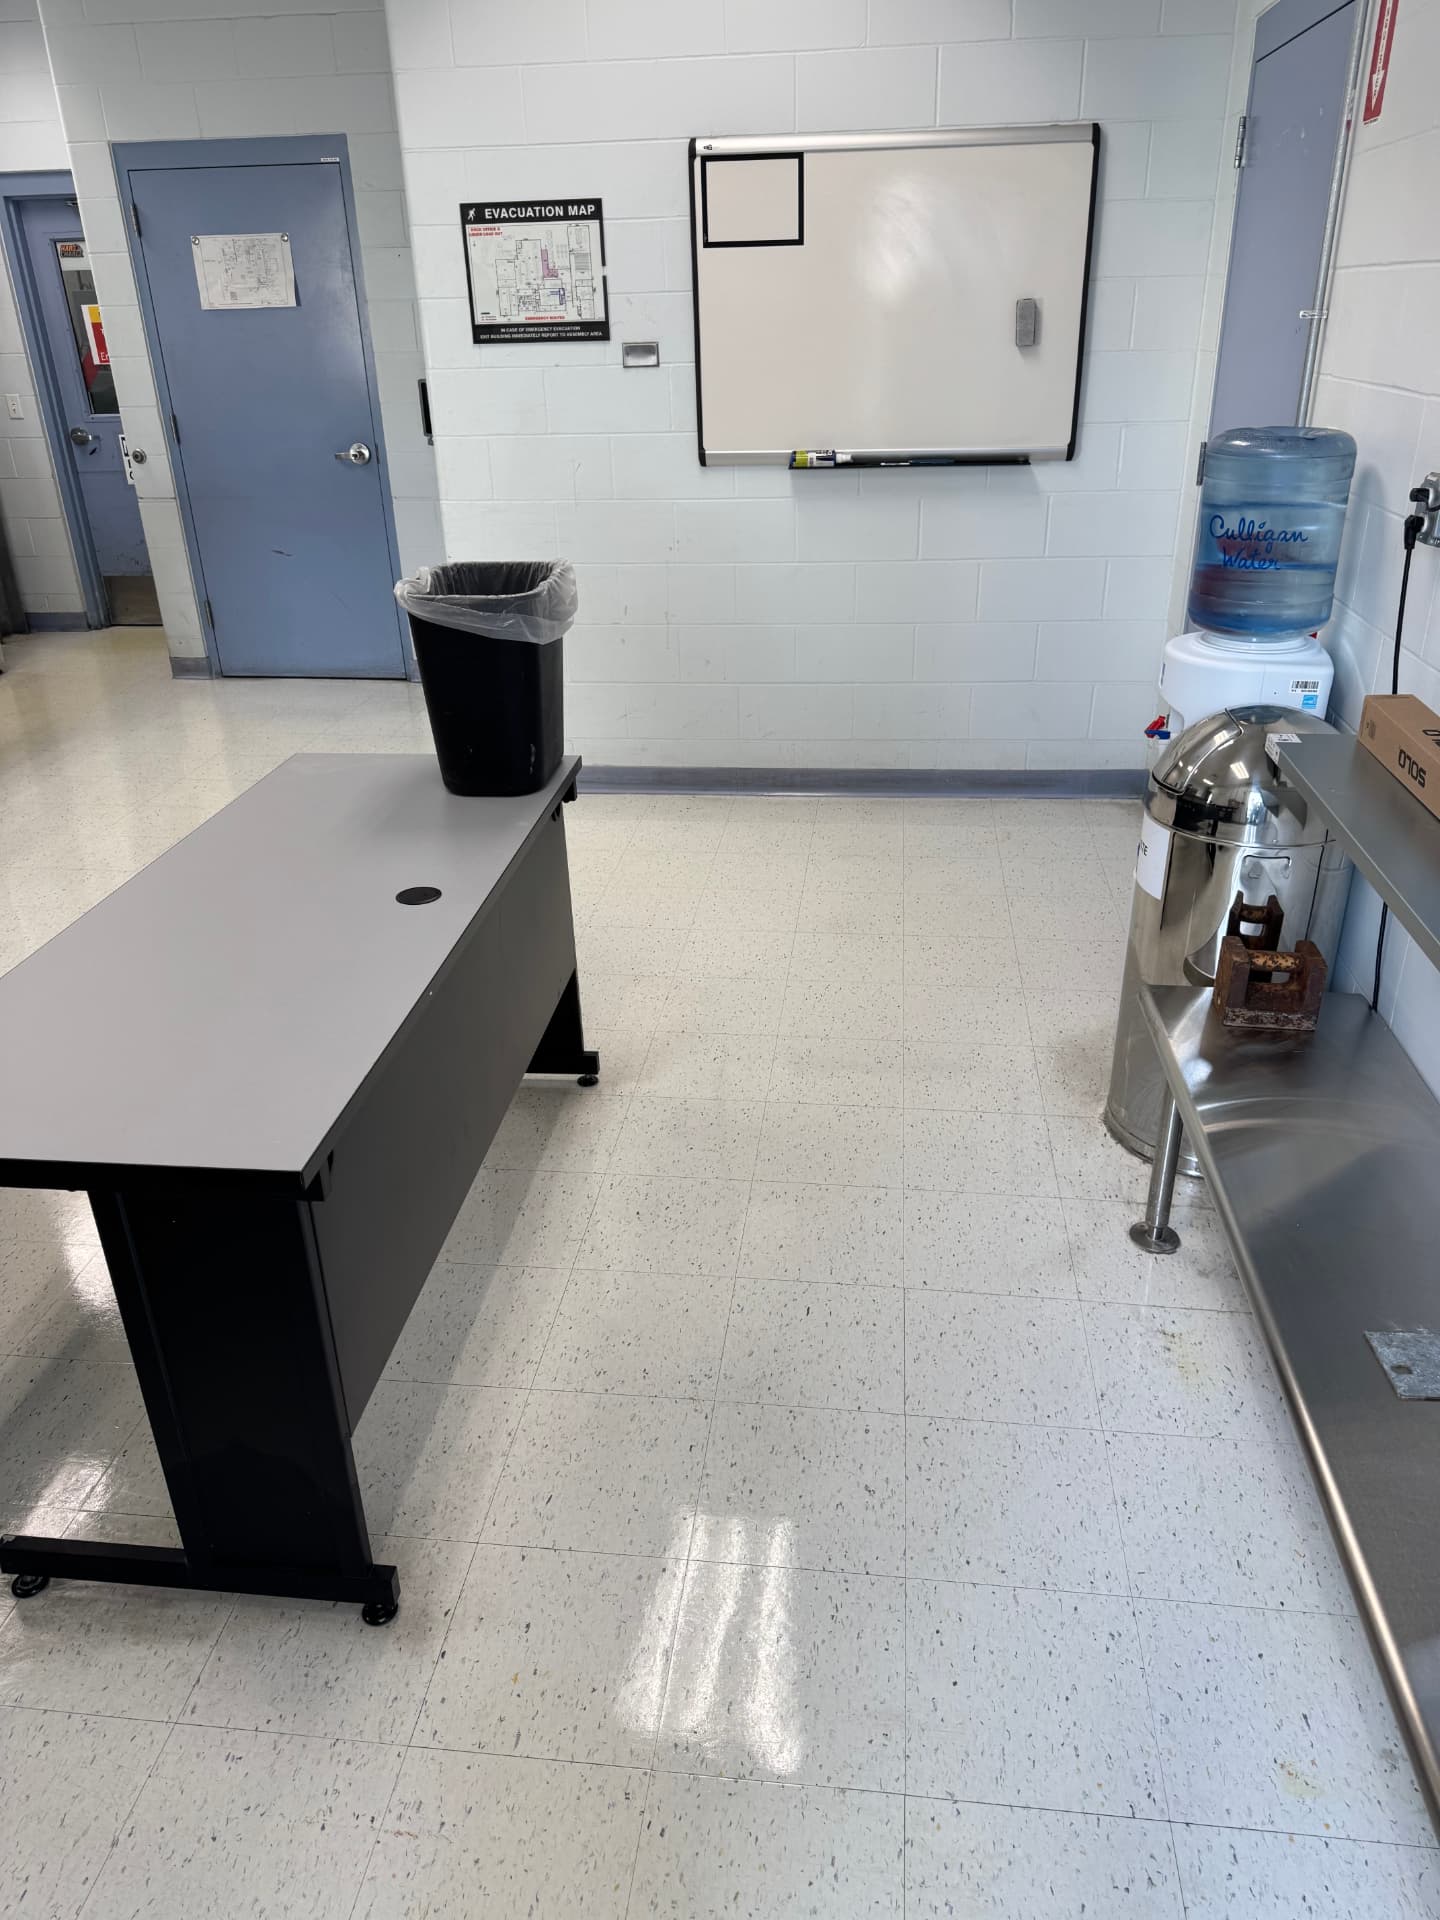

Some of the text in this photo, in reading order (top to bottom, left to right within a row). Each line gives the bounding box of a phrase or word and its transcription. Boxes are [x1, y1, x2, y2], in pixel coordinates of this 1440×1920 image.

[485, 204, 596, 219] EVACUATION MAP
[1209, 514, 1308, 553] Culligan
[1222, 545, 1281, 570] Water
[1398, 748, 1427, 788] SOLO
